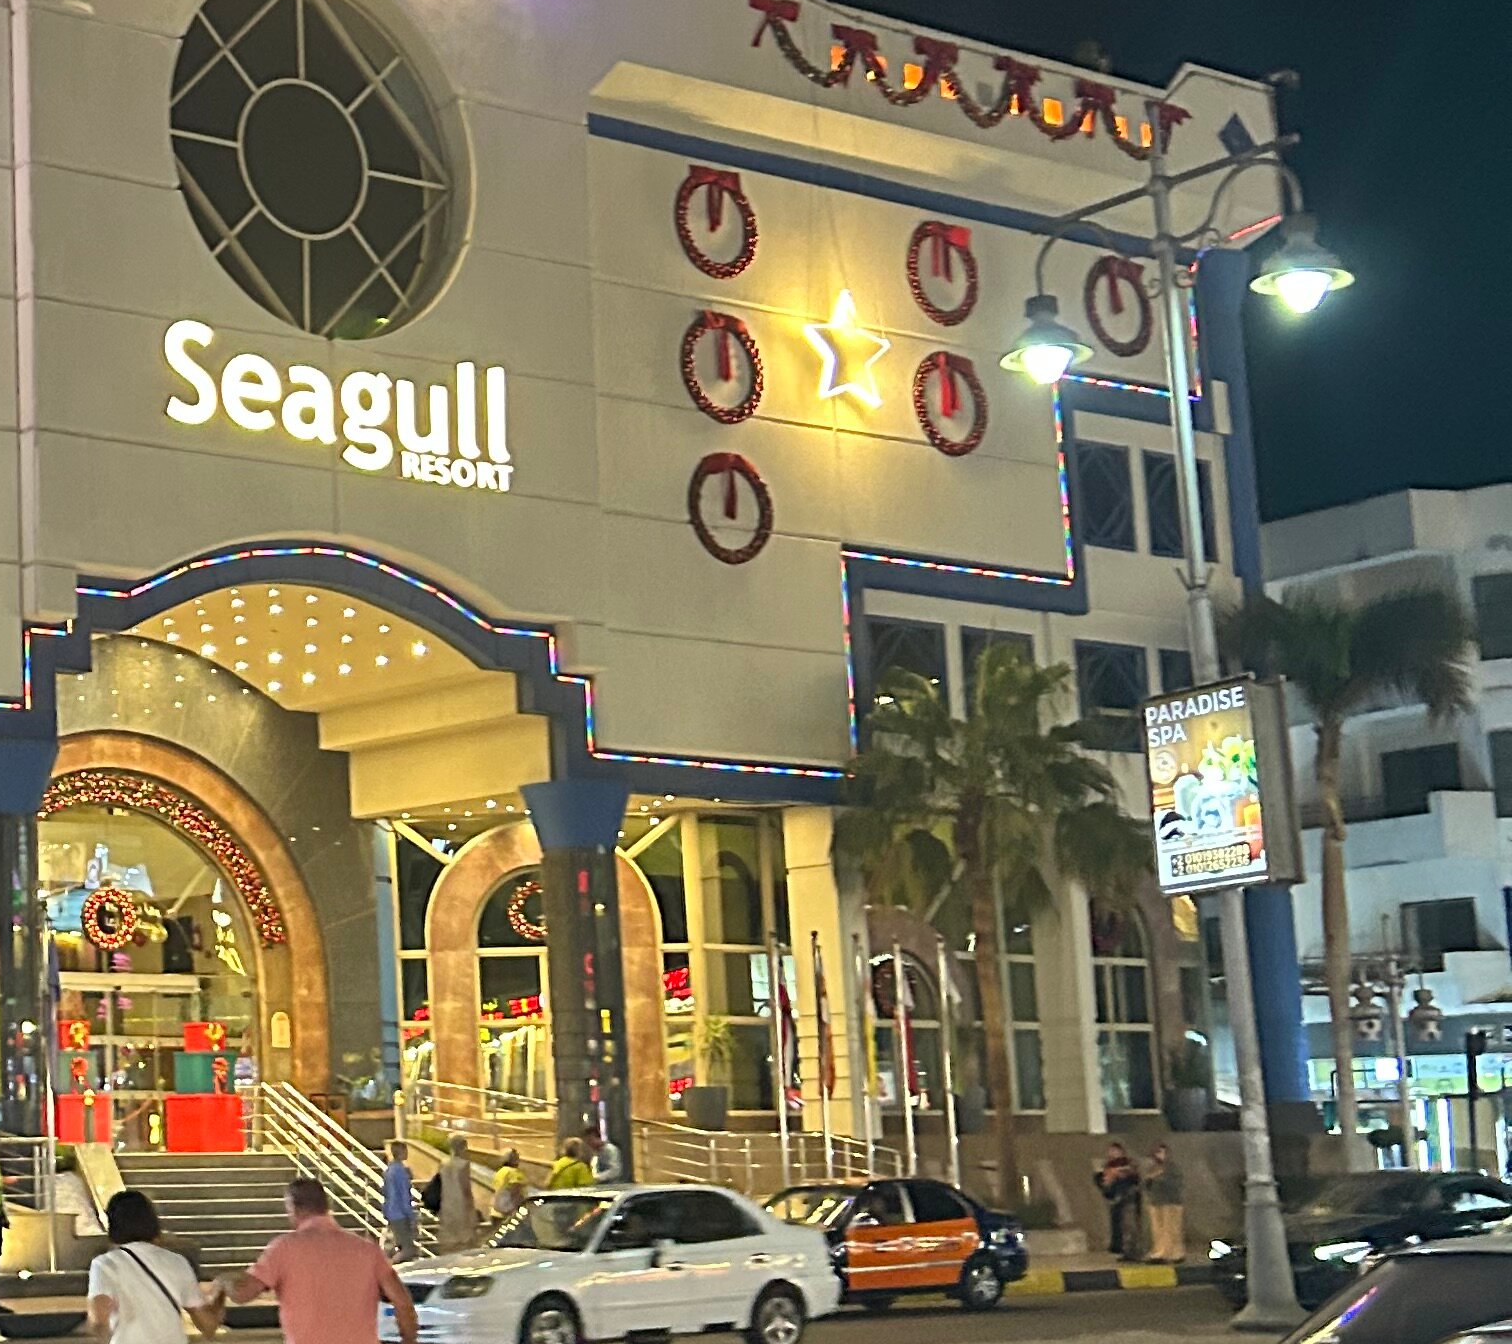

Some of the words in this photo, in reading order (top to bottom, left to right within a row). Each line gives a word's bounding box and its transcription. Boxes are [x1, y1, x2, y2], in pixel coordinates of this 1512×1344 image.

[163, 319, 511, 472] Seagull
[400, 450, 514, 493] RESORT
[1145, 686, 1245, 727] PARADISE
[1147, 723, 1187, 748] SPA
